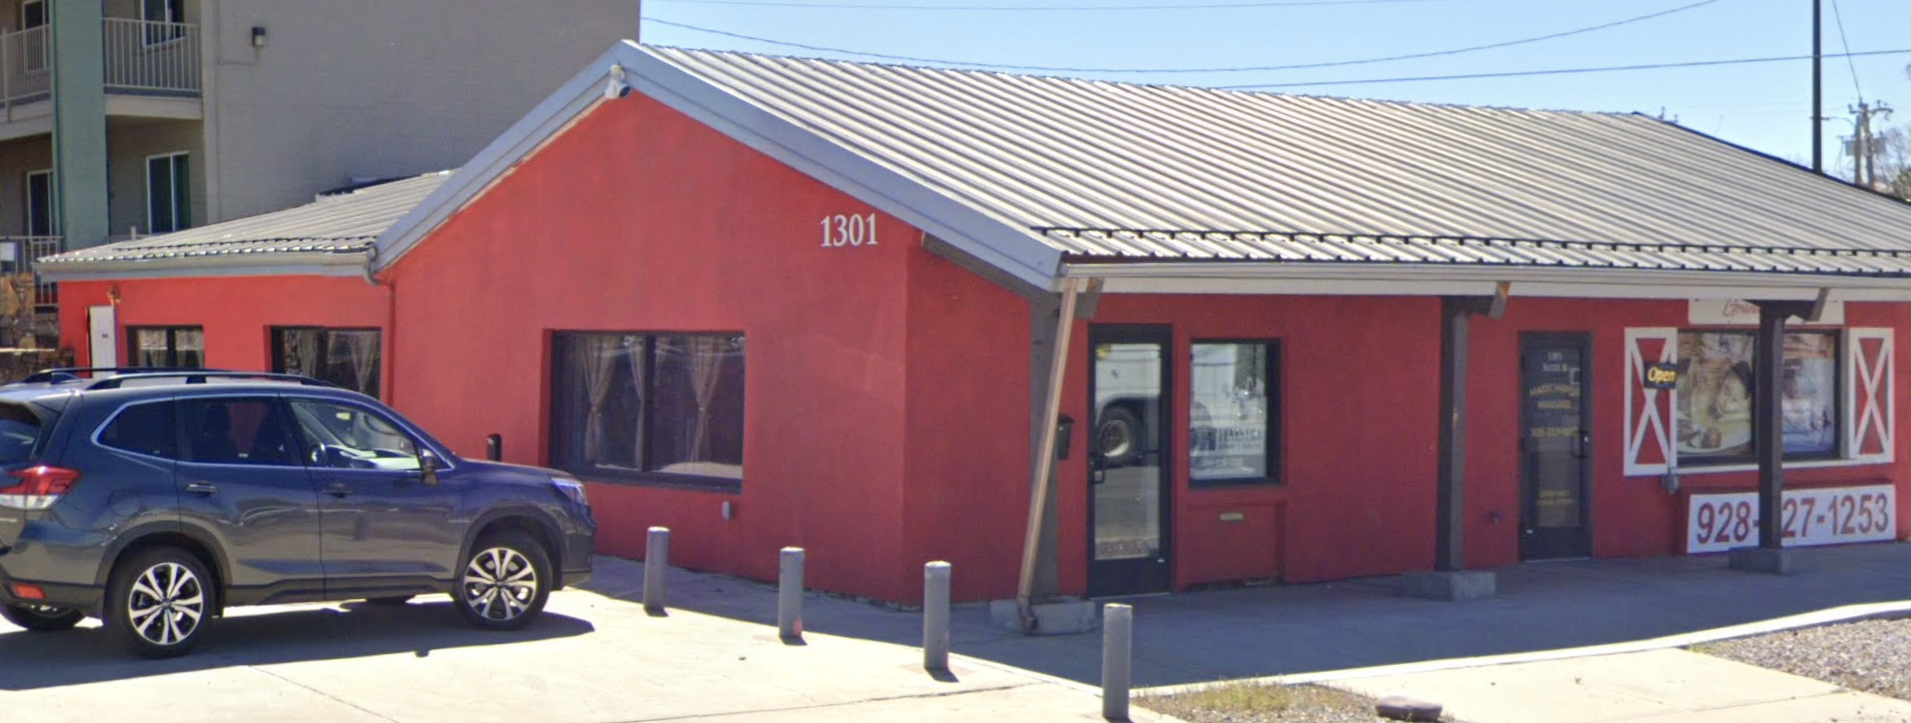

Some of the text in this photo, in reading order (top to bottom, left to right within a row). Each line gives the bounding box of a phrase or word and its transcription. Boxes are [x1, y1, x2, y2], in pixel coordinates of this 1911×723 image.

[820, 212, 878, 247] 1301
[1647, 366, 1676, 384] Open
[1696, 493, 1889, 544] 928-27-1253
